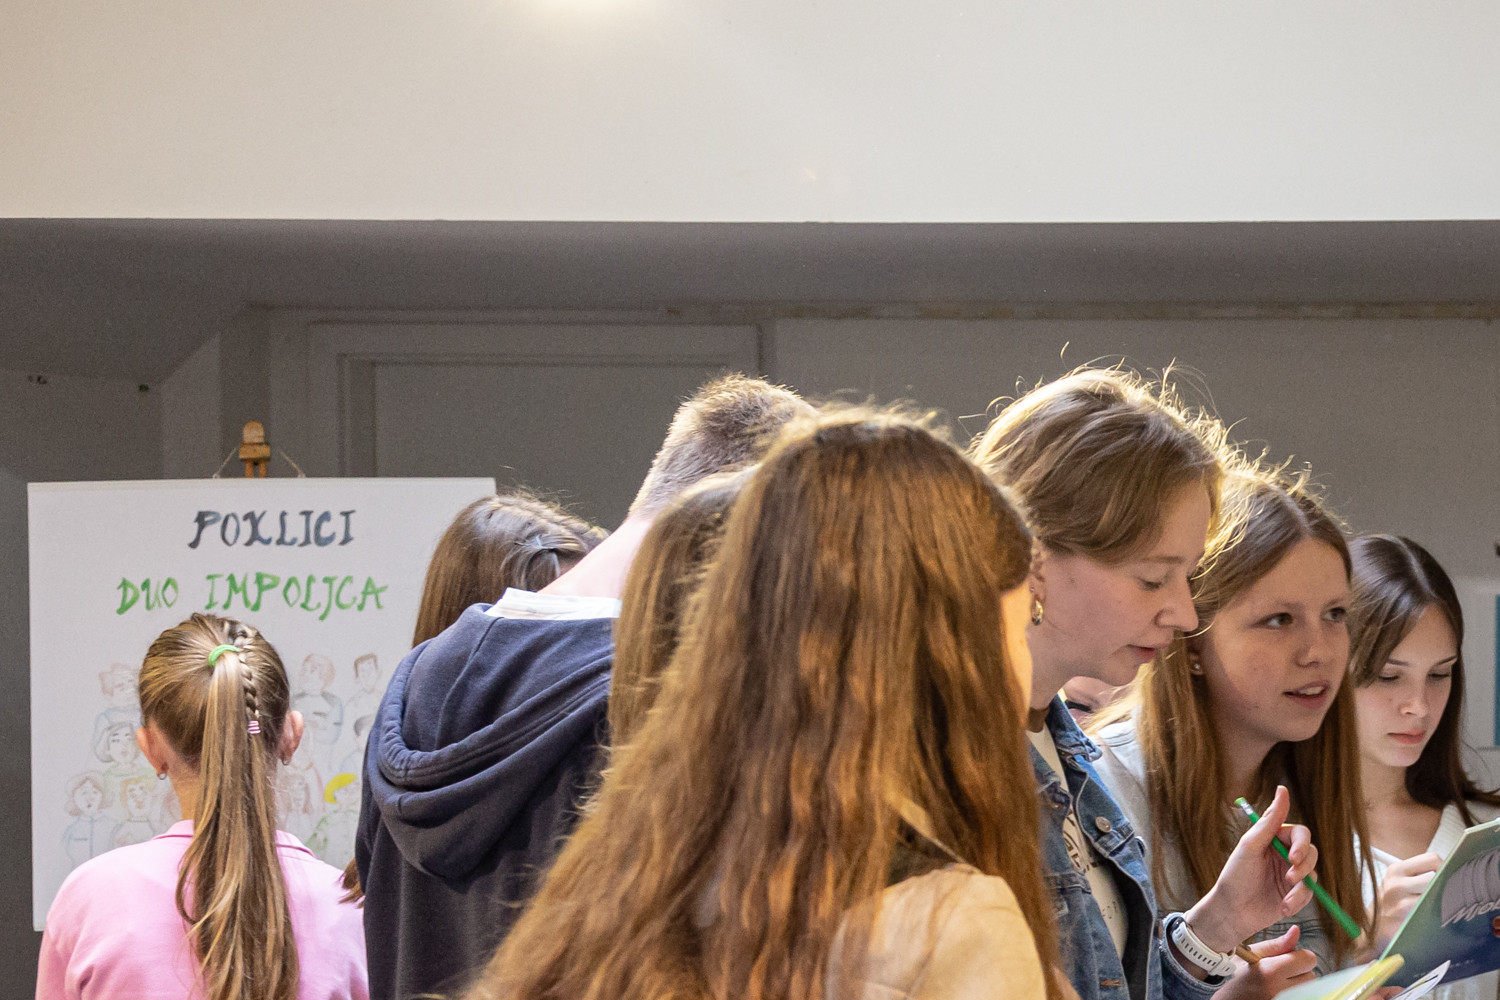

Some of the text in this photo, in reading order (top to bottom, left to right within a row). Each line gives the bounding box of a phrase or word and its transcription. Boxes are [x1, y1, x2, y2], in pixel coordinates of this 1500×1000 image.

[187, 509, 356, 549] POKLICI
[116, 572, 388, 621] DUO IMPOLJCA
